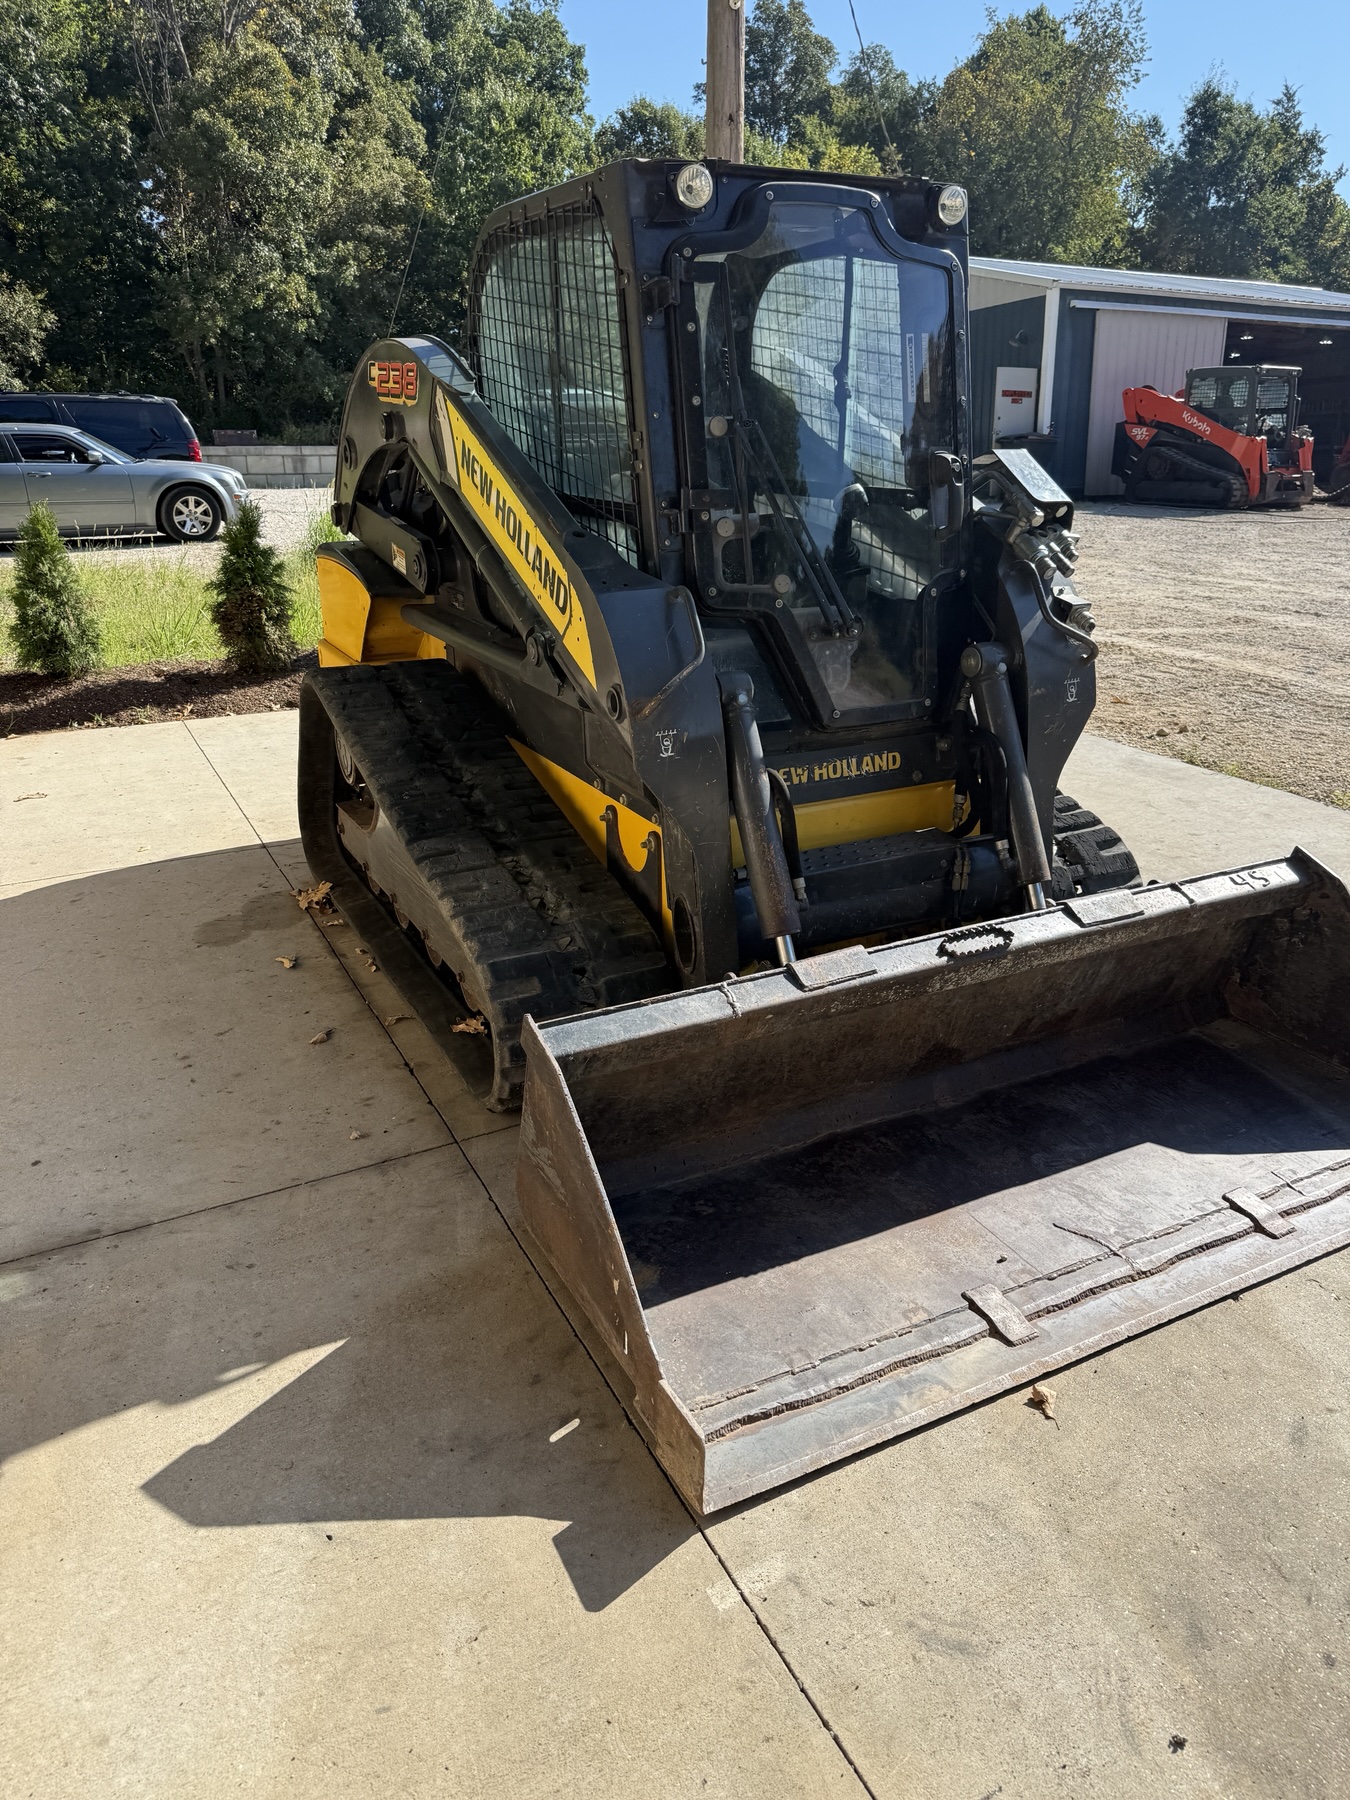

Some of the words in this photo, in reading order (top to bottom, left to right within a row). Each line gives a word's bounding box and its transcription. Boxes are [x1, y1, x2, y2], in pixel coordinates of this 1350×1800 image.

[1131, 427, 1149, 436] SVL
[1181, 411, 1211, 435] Kubota
[461, 438, 494, 507] NEW
[495, 487, 568, 616] HOLLAND
[778, 764, 809, 786] EW
[814, 751, 901, 781] HOLLAND
